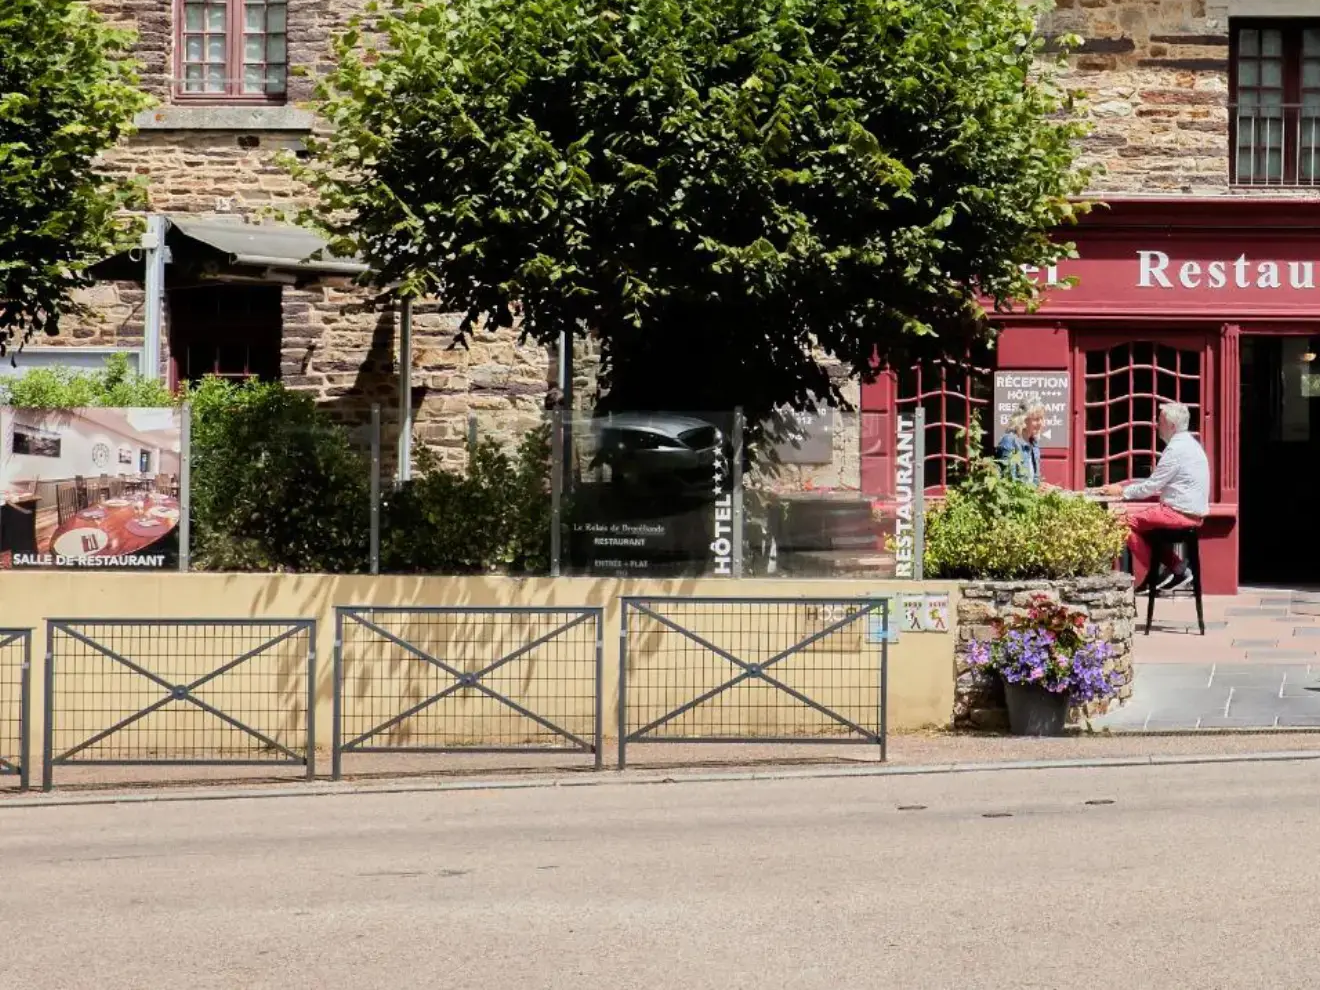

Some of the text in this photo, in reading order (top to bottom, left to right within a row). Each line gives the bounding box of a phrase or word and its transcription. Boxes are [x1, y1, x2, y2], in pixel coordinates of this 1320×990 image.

[996, 376, 1068, 388] RÉCEPTION
[896, 416, 914, 577] RESTAURANT
[710, 494, 732, 574] HÔTEL
[594, 537, 646, 546] RESTAURANT
[13, 554, 165, 567] SALLE DE RESTAURANT
